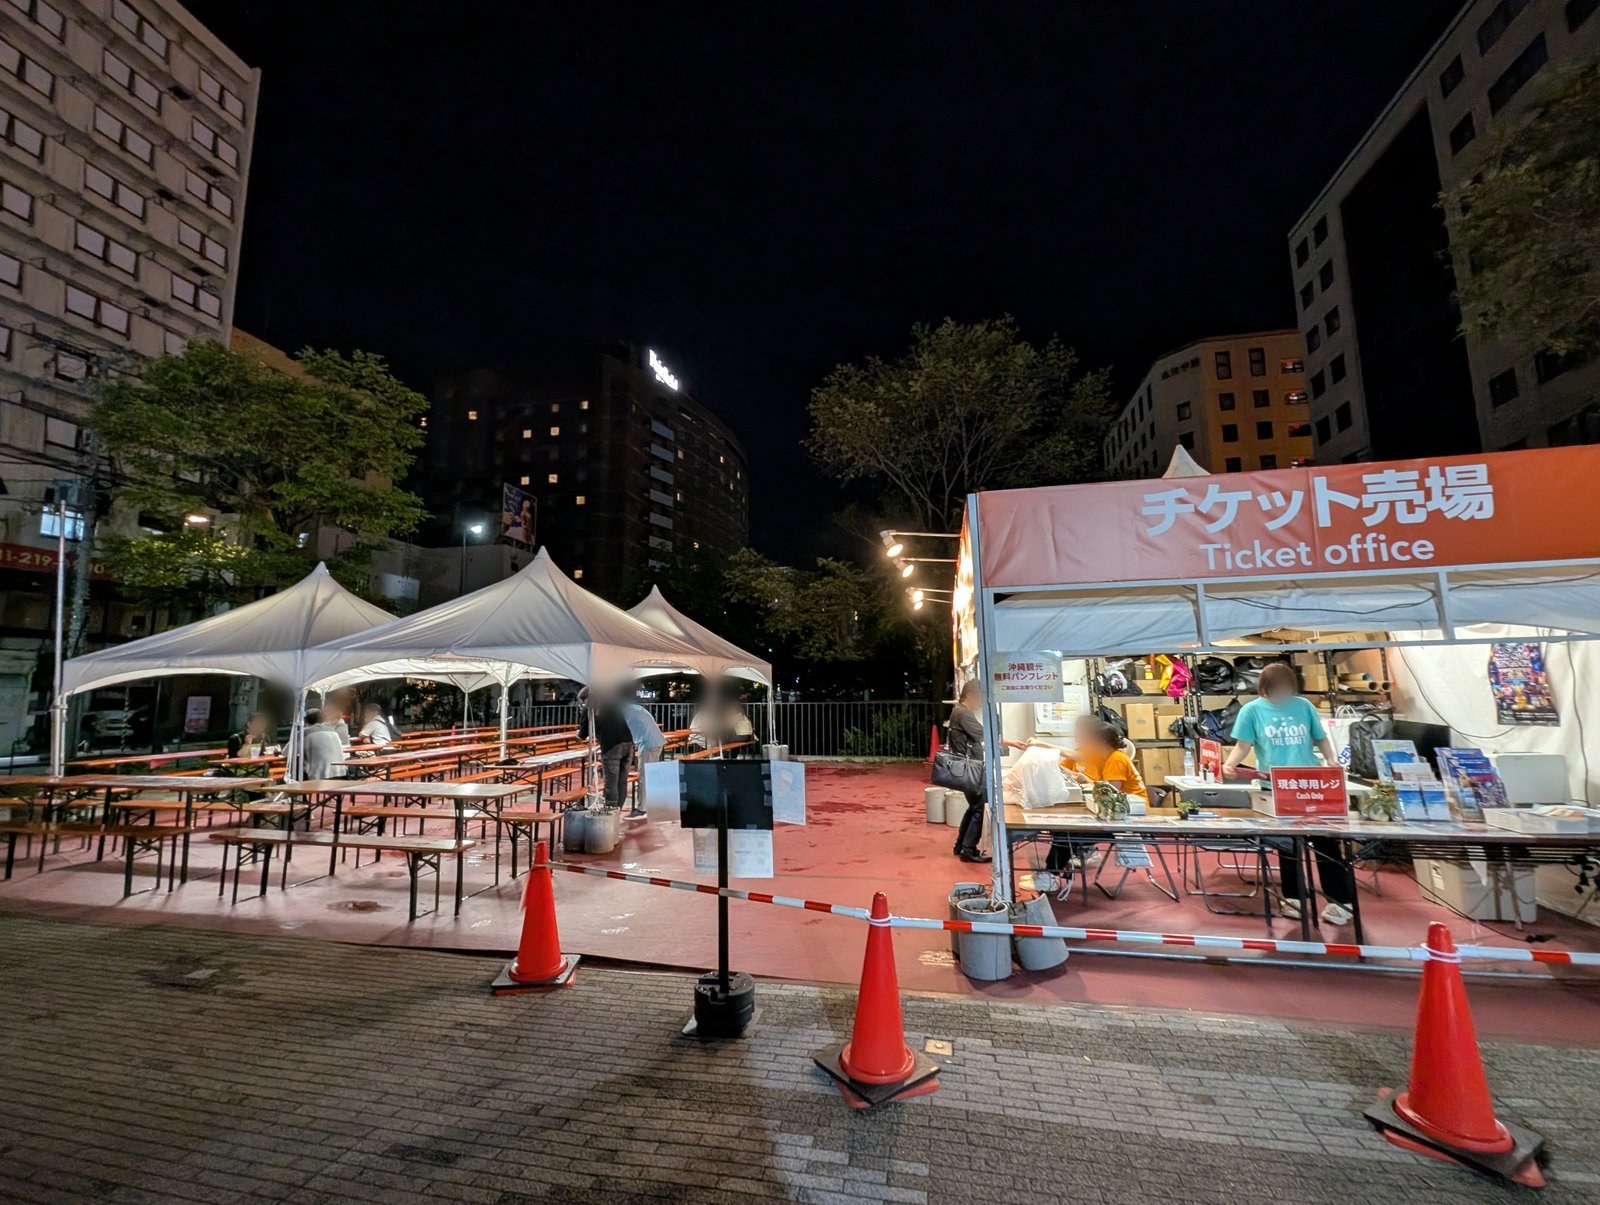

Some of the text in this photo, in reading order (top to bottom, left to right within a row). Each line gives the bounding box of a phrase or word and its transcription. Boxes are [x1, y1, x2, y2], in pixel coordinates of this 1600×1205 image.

[1141, 463, 1494, 537] チケット売場
[1199, 533, 1435, 570] Ticket office
[1008, 662, 1044, 671] 沖縄観光
[994, 672, 1058, 682] 無料パンフレット
[1277, 778, 1341, 790] 現金専用レジ
[1296, 792, 1325, 801] Cash Only
